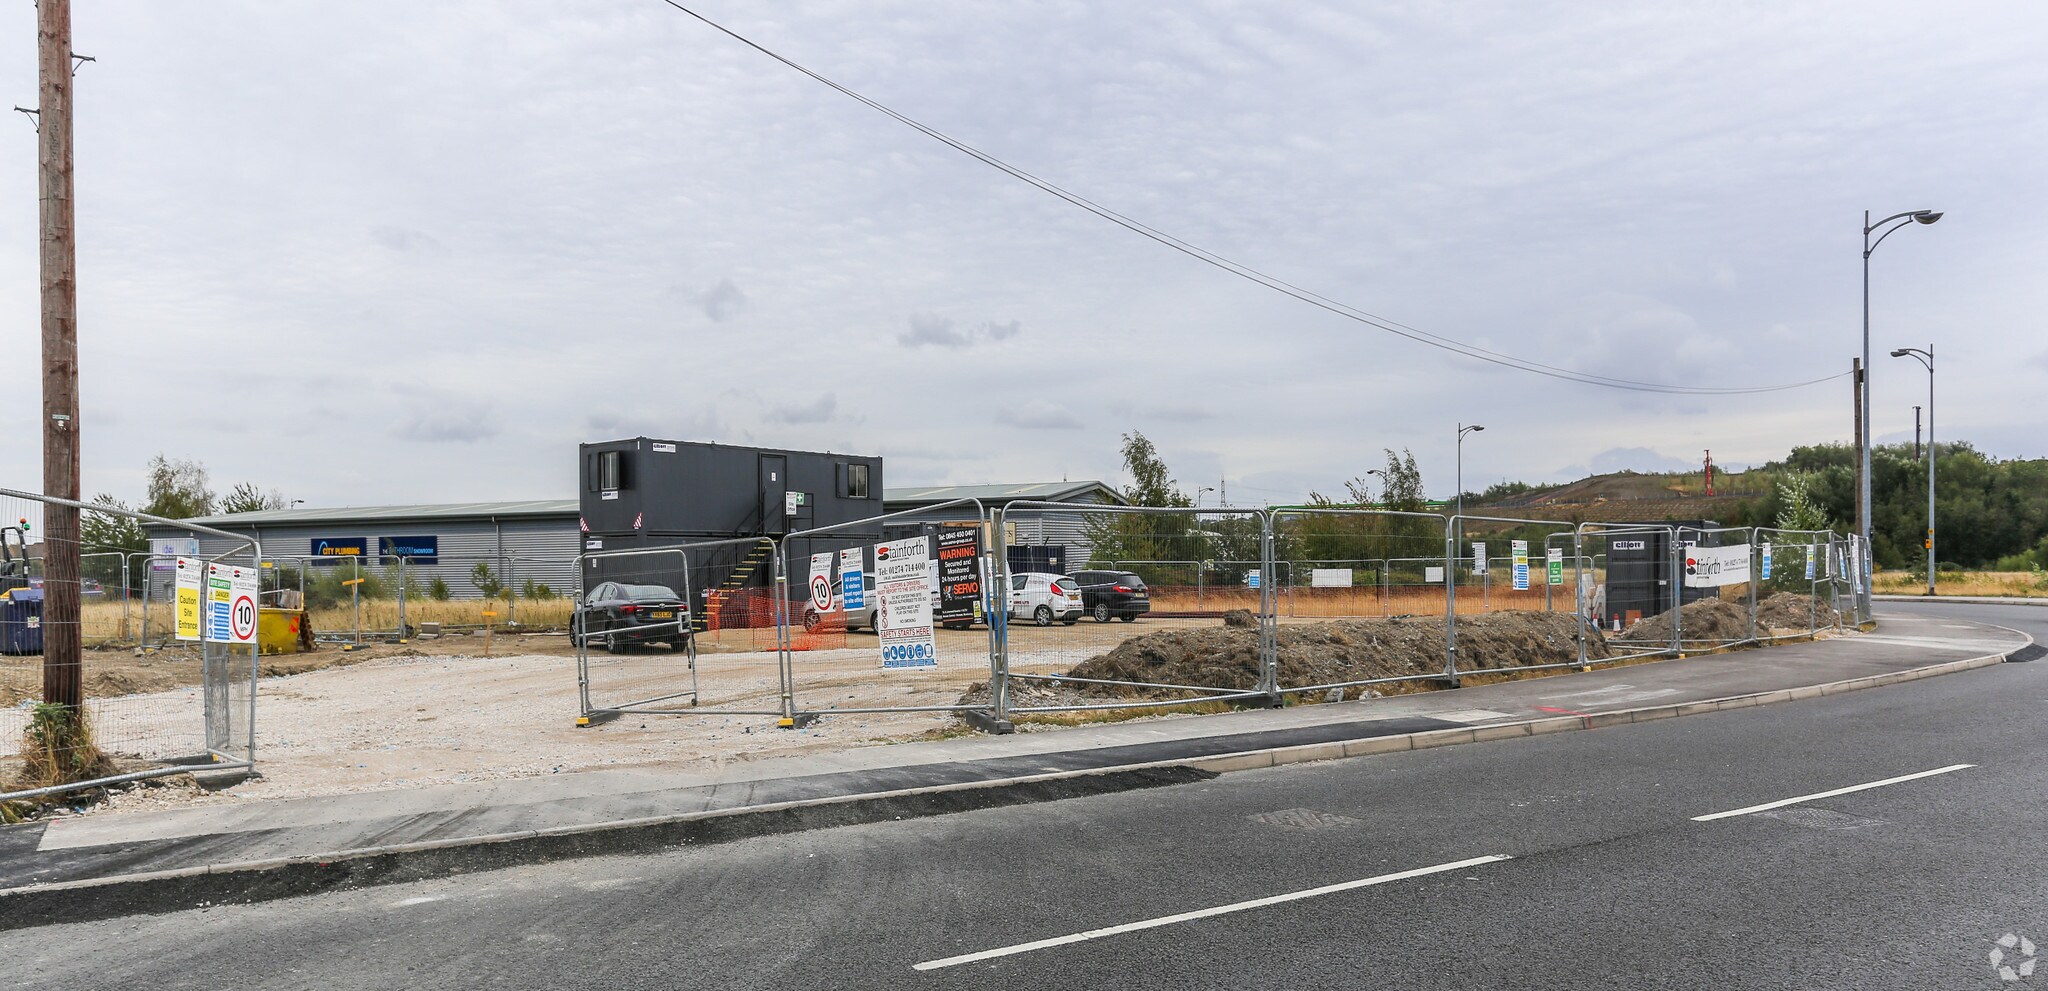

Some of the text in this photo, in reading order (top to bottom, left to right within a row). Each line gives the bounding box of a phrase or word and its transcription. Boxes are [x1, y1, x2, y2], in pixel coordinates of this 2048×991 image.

[940, 547, 975, 560] WARNING
[1686, 557, 1720, 575] Stinforth
[815, 584, 826, 598] 10
[953, 582, 978, 594] SERVO
[180, 595, 196, 605] Caution
[184, 608, 192, 617] Site
[238, 606, 251, 624] 10
[179, 620, 198, 629] Entrance
[898, 629, 915, 637] STARTS
